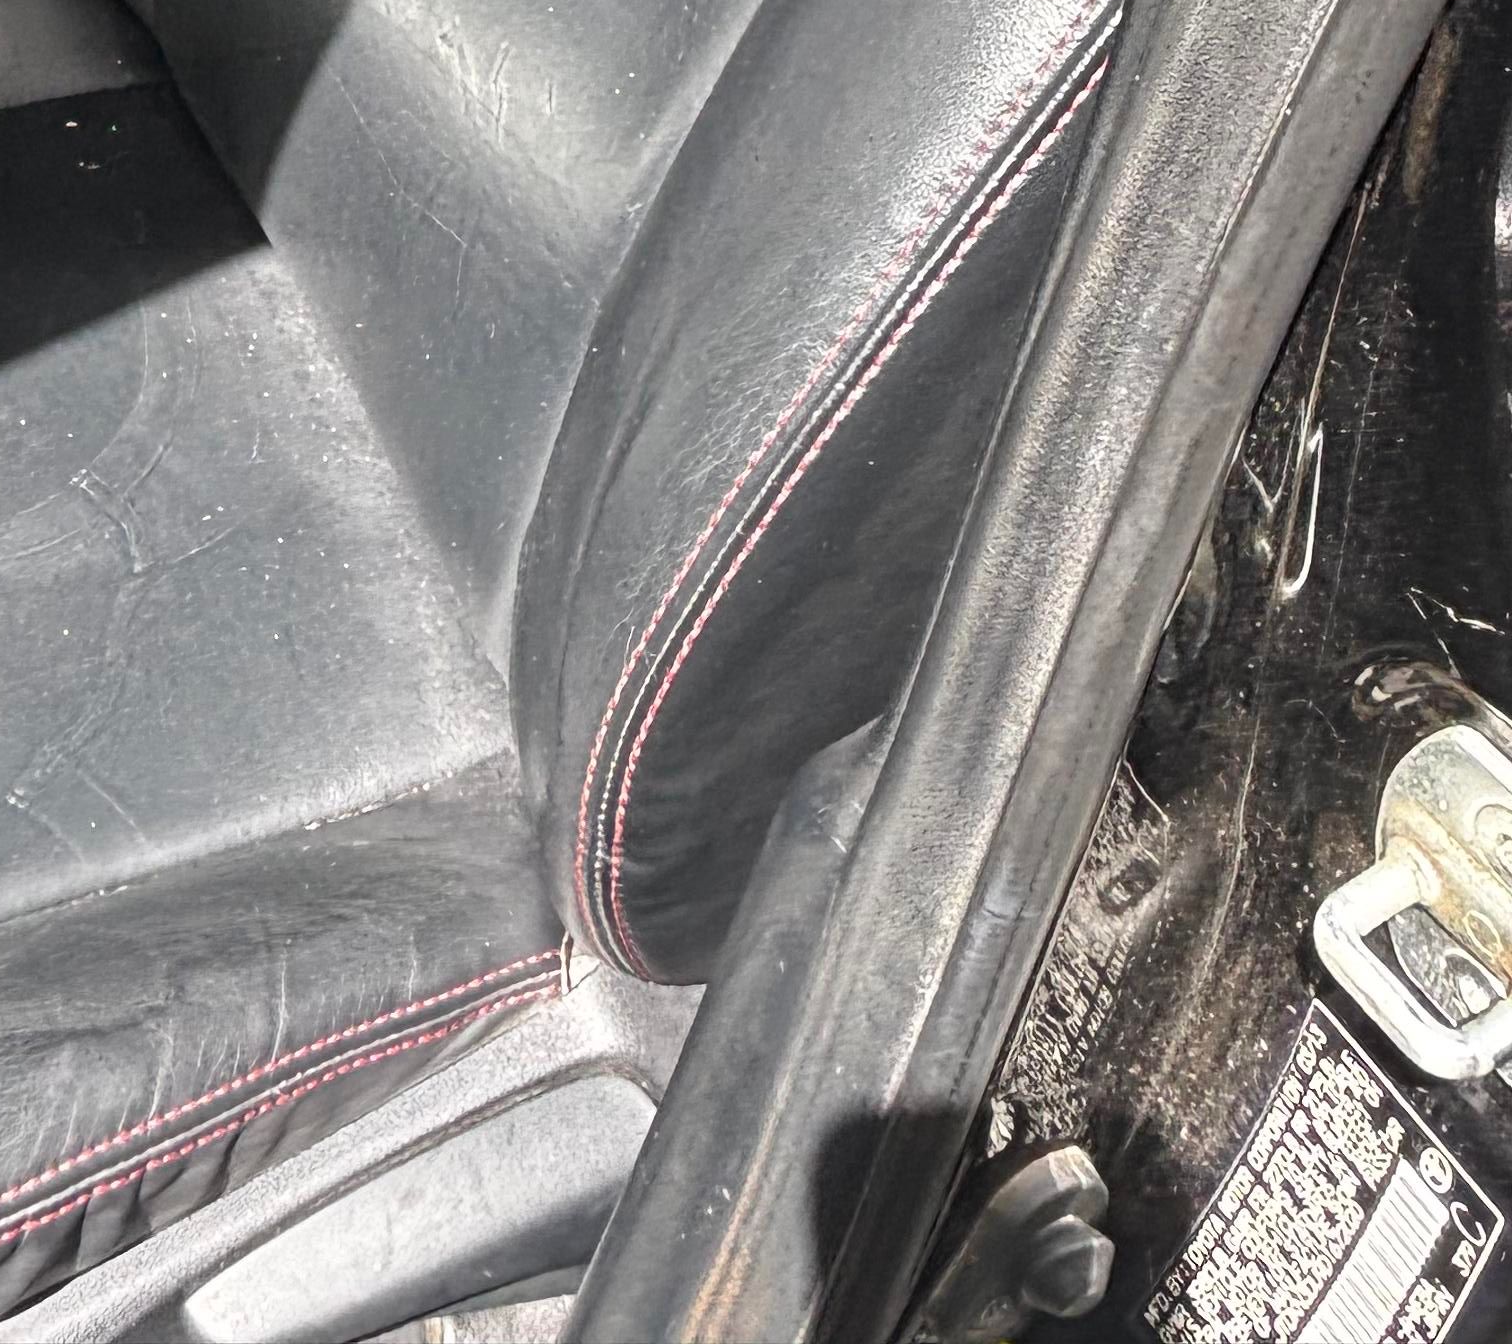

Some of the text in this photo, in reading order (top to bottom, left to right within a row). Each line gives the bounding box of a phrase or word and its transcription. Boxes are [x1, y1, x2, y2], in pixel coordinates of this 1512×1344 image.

[1182, 1208, 1227, 1272] TOYOTA
[1216, 1161, 1256, 1221] MOTOR
[1244, 1071, 1306, 1174] CORPORATION
